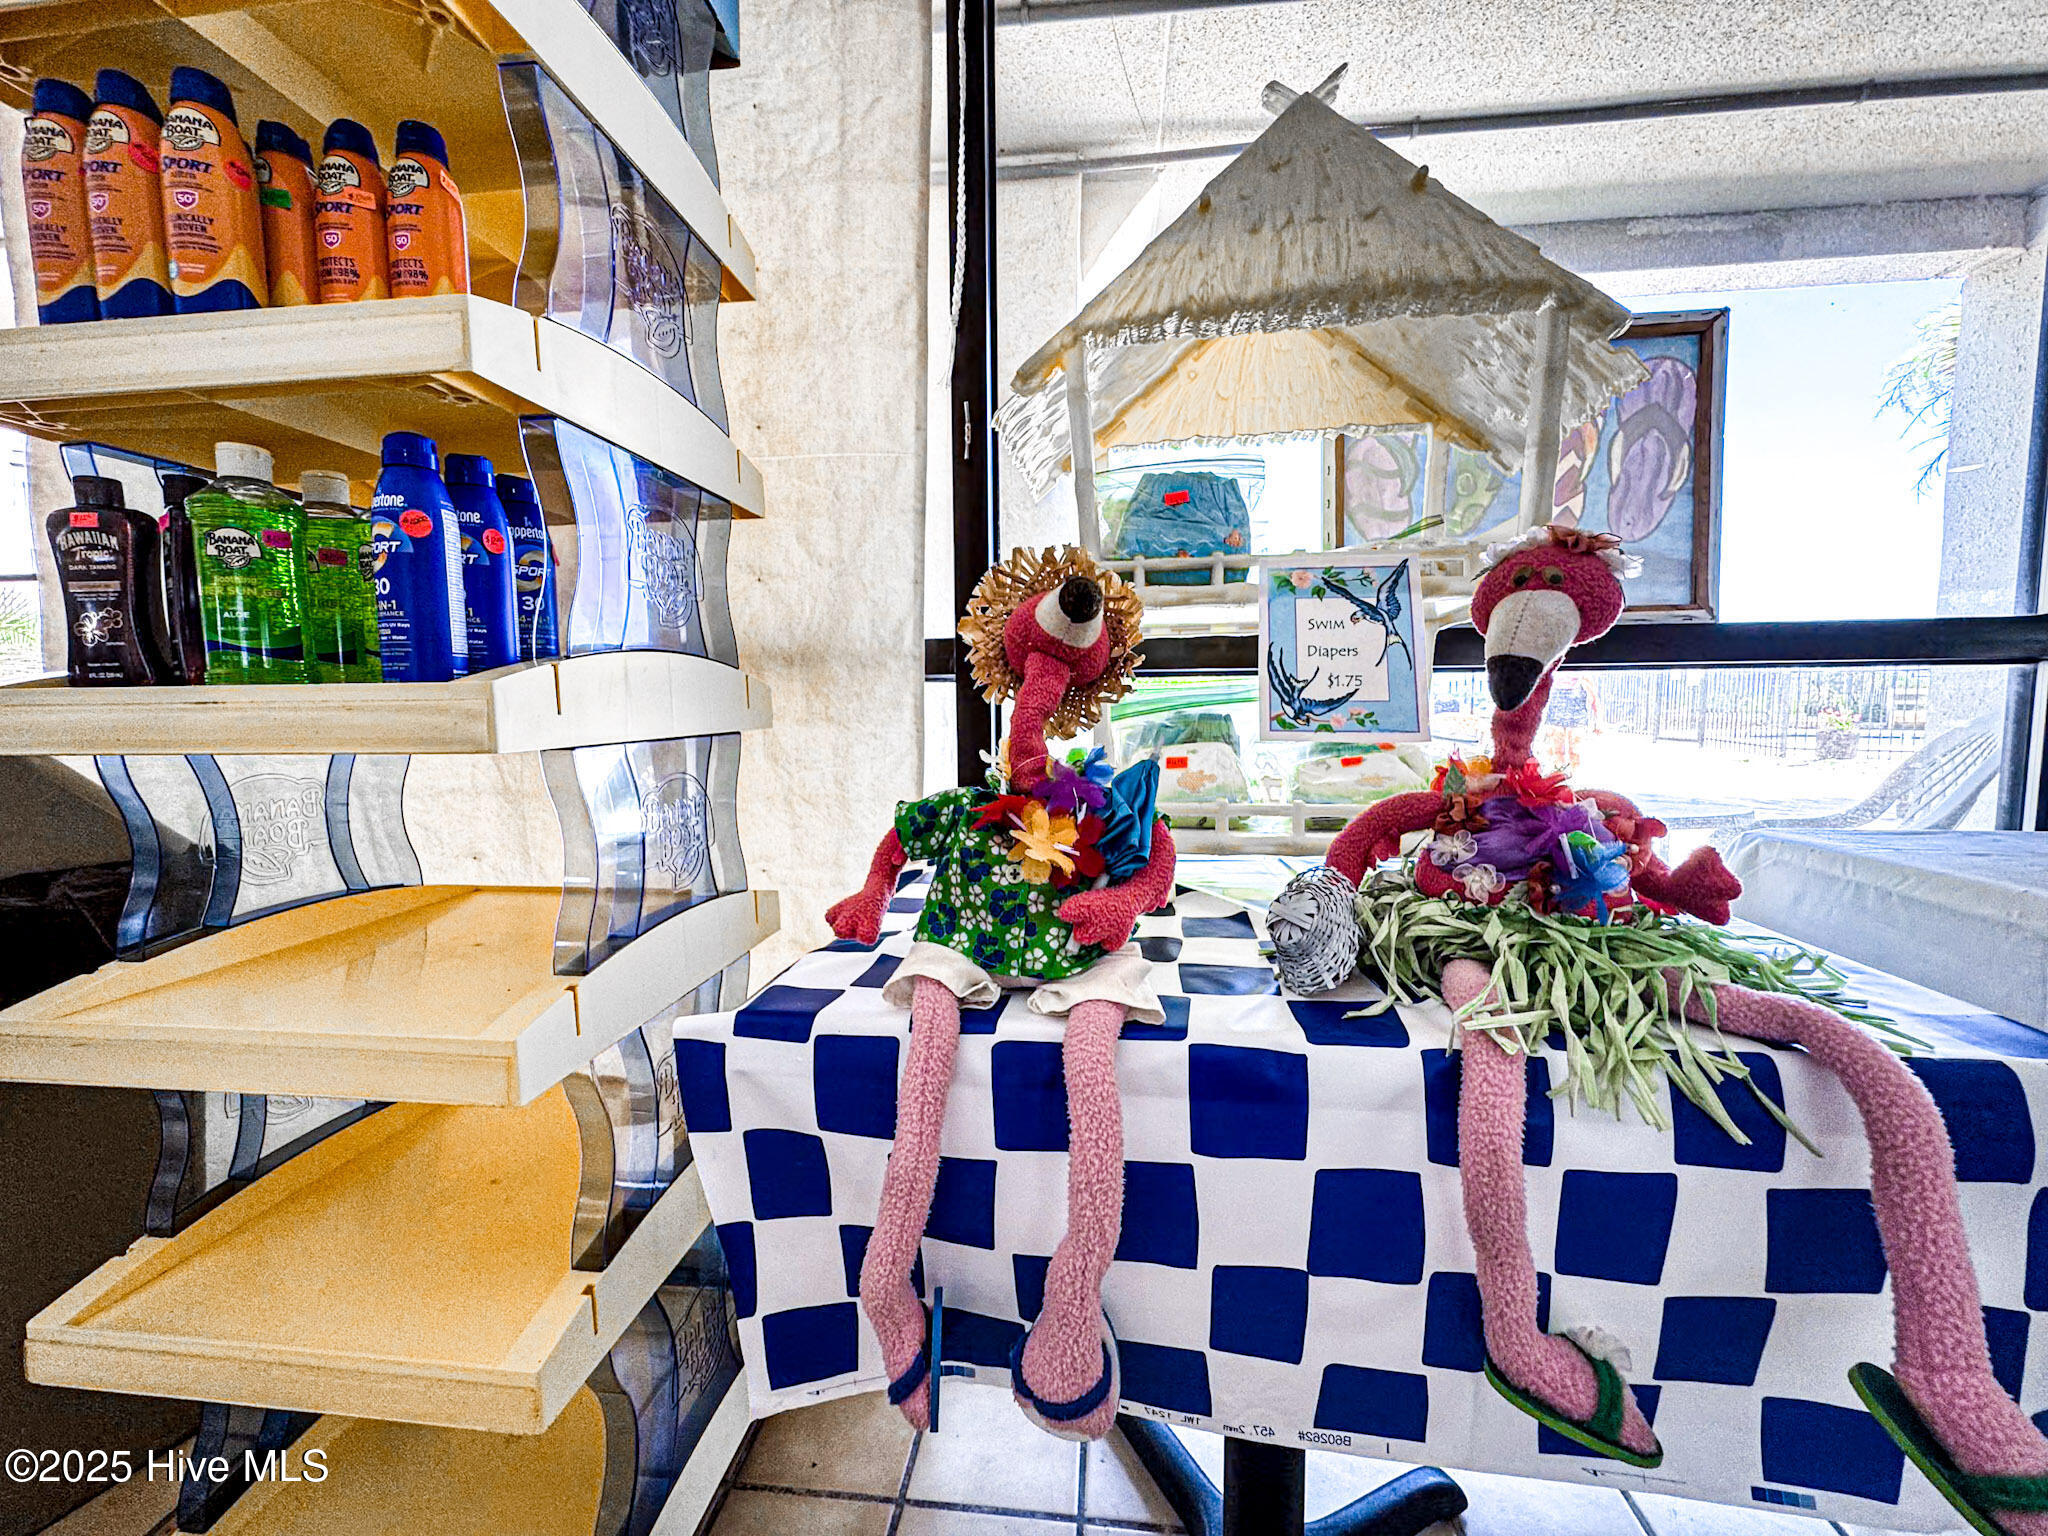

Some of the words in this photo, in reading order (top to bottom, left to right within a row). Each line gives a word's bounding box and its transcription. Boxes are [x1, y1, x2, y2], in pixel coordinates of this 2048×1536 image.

[319, 163, 355, 174] ANANA
[325, 234, 338, 244] 50
[396, 236, 408, 246] 50
[60, 530, 119, 551] HAWAIIAN
[205, 532, 256, 549] BANANA
[71, 545, 111, 561] Tropic
[215, 544, 248, 558] BOAT
[1308, 618, 1345, 630] SWIM
[1307, 645, 1359, 660] Diapers
[1327, 674, 1363, 688] $1.75
